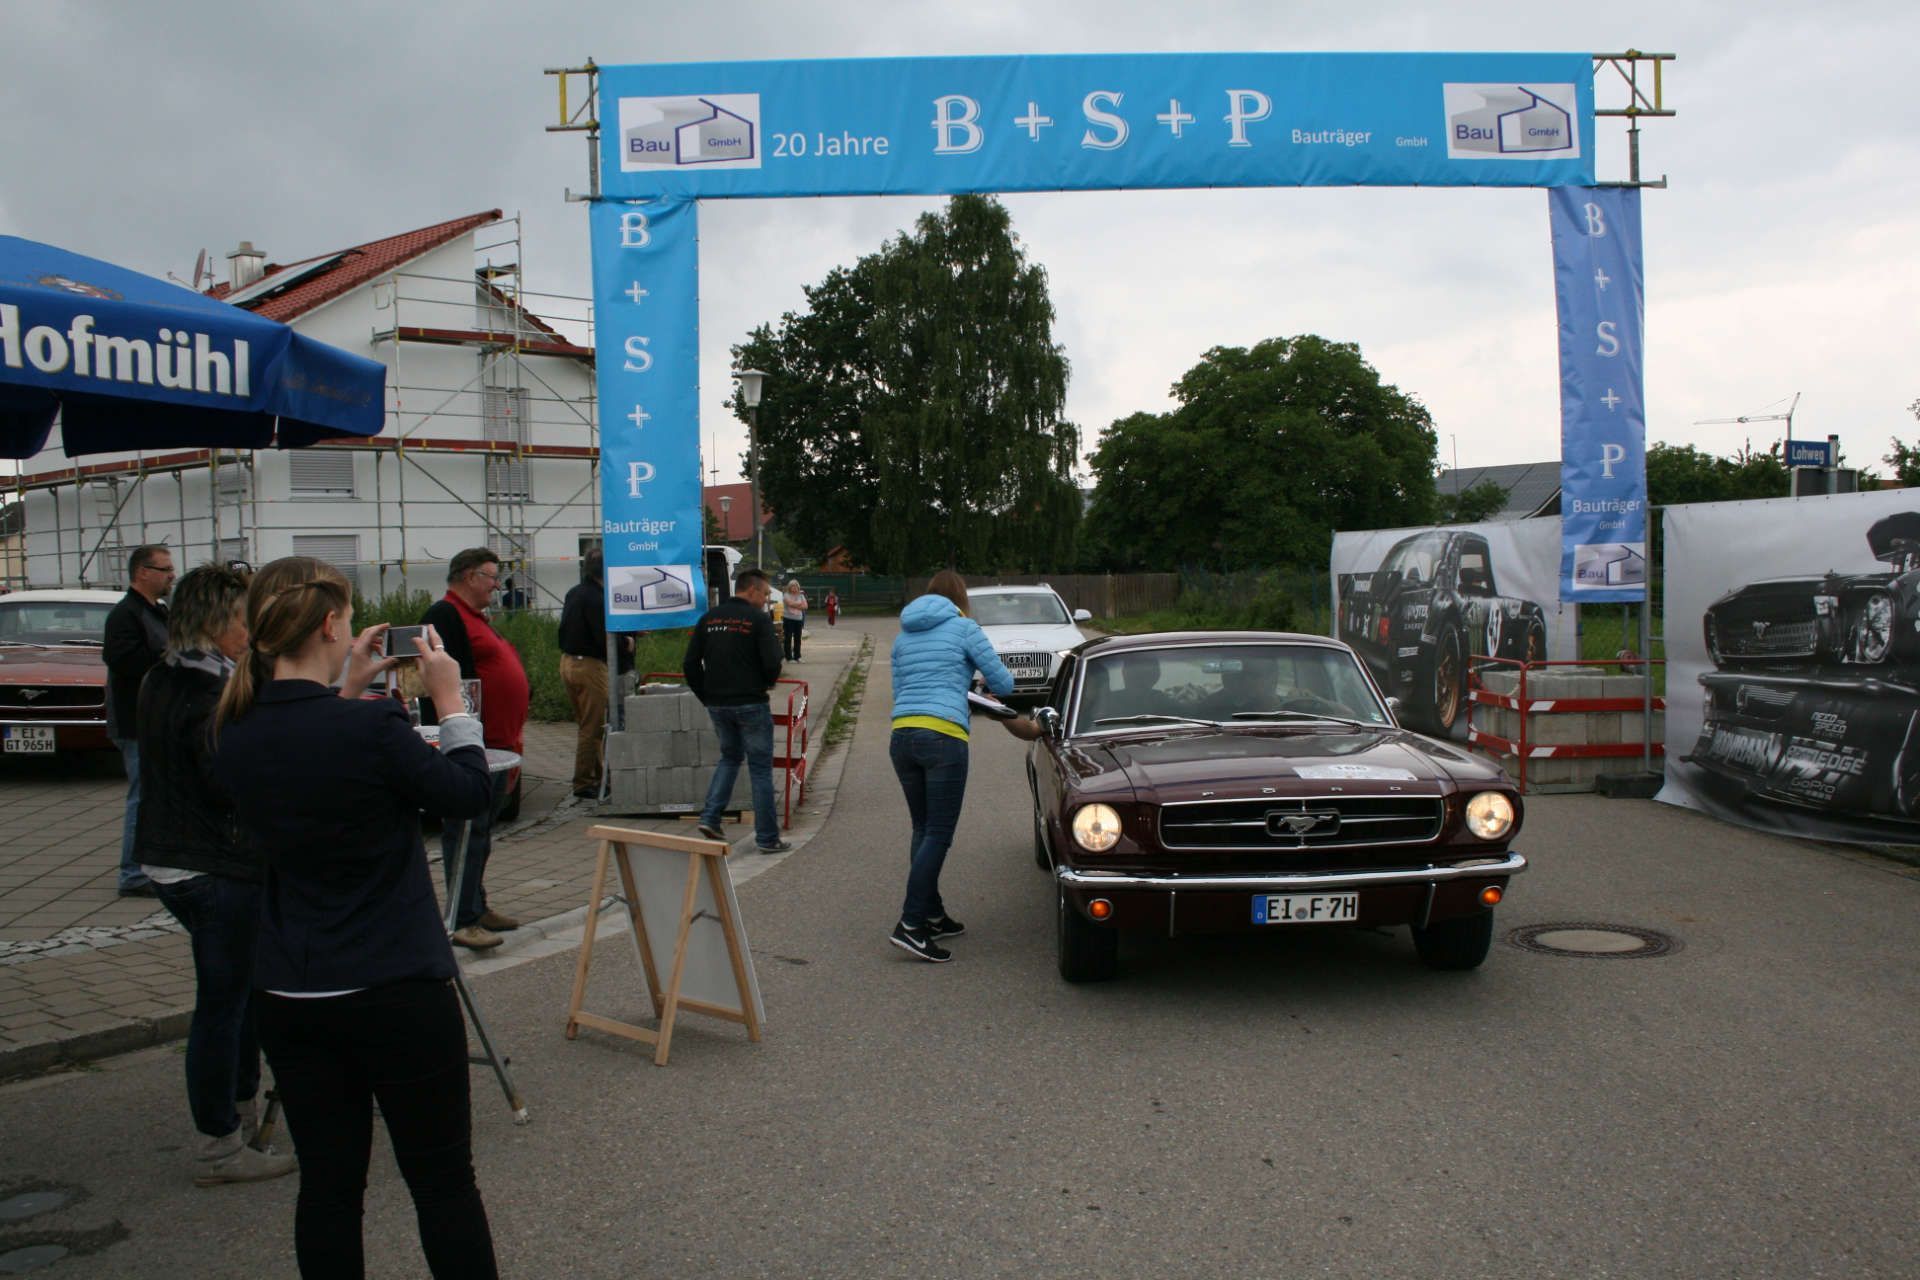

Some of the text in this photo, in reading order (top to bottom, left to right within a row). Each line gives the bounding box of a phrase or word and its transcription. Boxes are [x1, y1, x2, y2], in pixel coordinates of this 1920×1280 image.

[932, 95, 984, 155] B
[1081, 91, 1129, 151] S
[1225, 90, 1273, 148] P
[1292, 127, 1428, 147] Bauträger GmbH
[1456, 124, 1560, 141] Bau GmbH
[630, 136, 742, 153] Bau GmbH
[773, 132, 889, 157] 20 Jahre
[1791, 445, 1825, 465] Lohweg
[1572, 497, 1641, 514] Bauträger
[604, 518, 676, 536] Bauträger
[1599, 519, 1626, 530] GmbH
[628, 541, 658, 551] GmbH
[614, 593, 638, 603] Bau
[23, 728, 35, 739] EI
[6, 740, 20, 751] GT
[1818, 752, 1866, 775] EDGE
[1791, 777, 1836, 794] GoPro
[1267, 898, 1292, 920] EI
